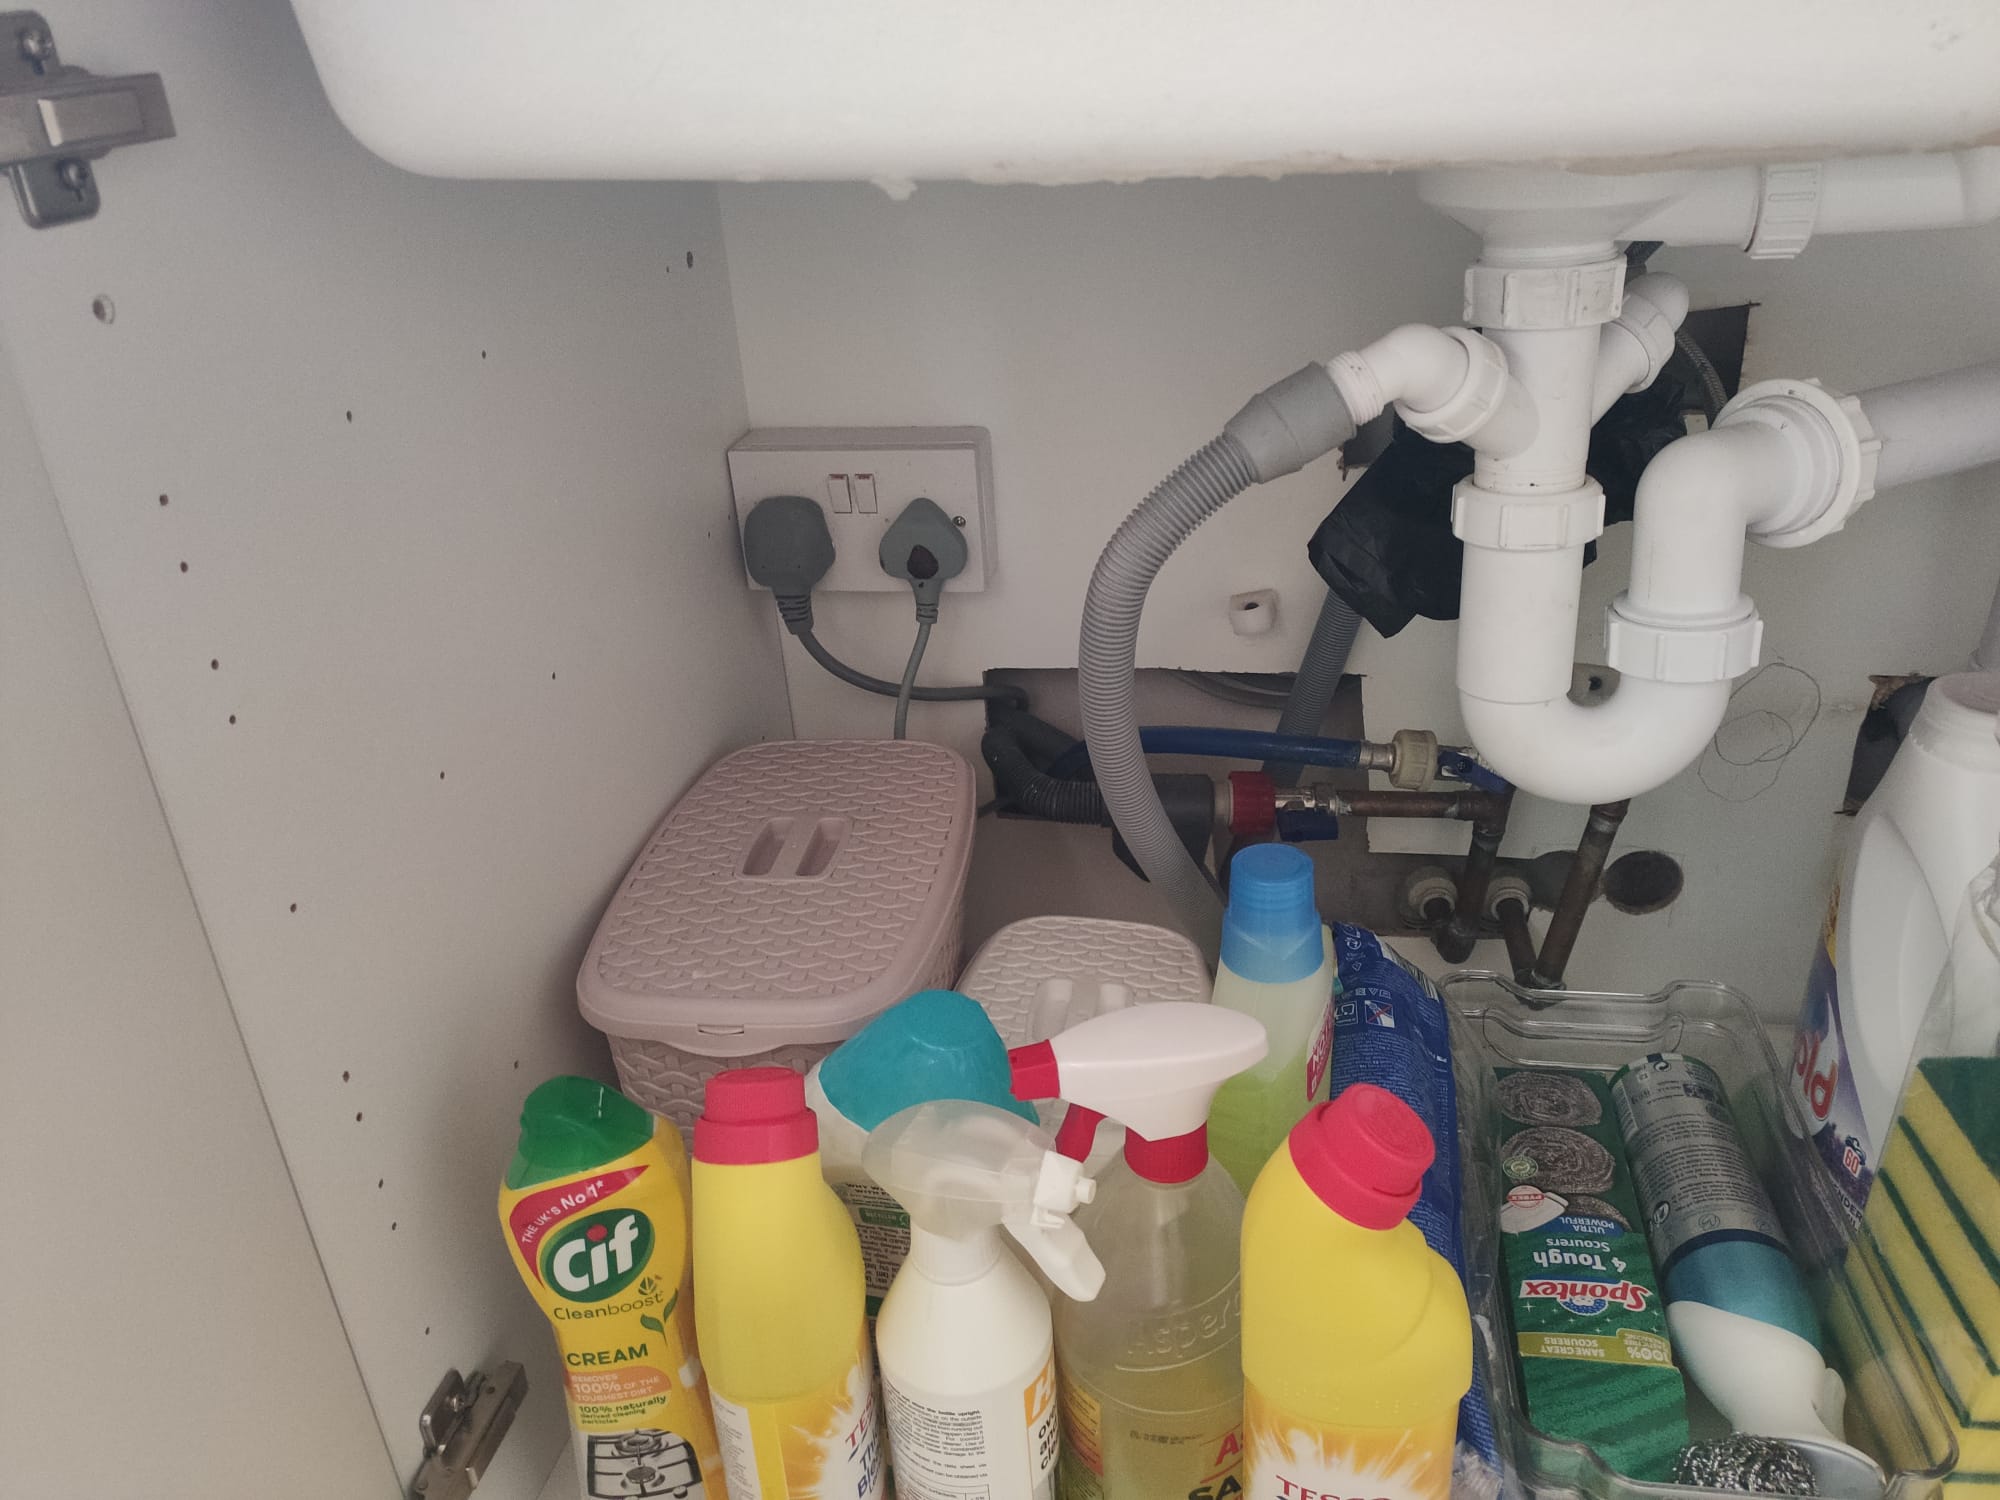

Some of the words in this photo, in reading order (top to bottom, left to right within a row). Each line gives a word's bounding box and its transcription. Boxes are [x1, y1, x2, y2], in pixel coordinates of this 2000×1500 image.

[1845, 1149, 1859, 1174] 60
[522, 1224, 538, 1243] THE
[533, 1205, 561, 1226] UK's
[1558, 1216, 1615, 1230] POWERFUL
[1572, 1224, 1606, 1235] ULTRA
[553, 1214, 639, 1292] Cif
[1546, 1238, 1611, 1253] Scourers
[1532, 1248, 1607, 1271] Tough
[1611, 1257, 1627, 1272] 4
[1525, 1282, 1648, 1310] Spontex
[553, 1293, 664, 1320] Cleanboost
[1544, 1337, 1598, 1347] SCOURERS
[567, 1343, 648, 1367] CREAM
[1540, 1345, 1576, 1356] GREAT
[1577, 1347, 1605, 1358] SAME
[1626, 1346, 1670, 1362] 100%
[573, 1381, 622, 1394] 100%
[579, 1405, 613, 1413] 100%
[615, 1395, 667, 1412] naturally
